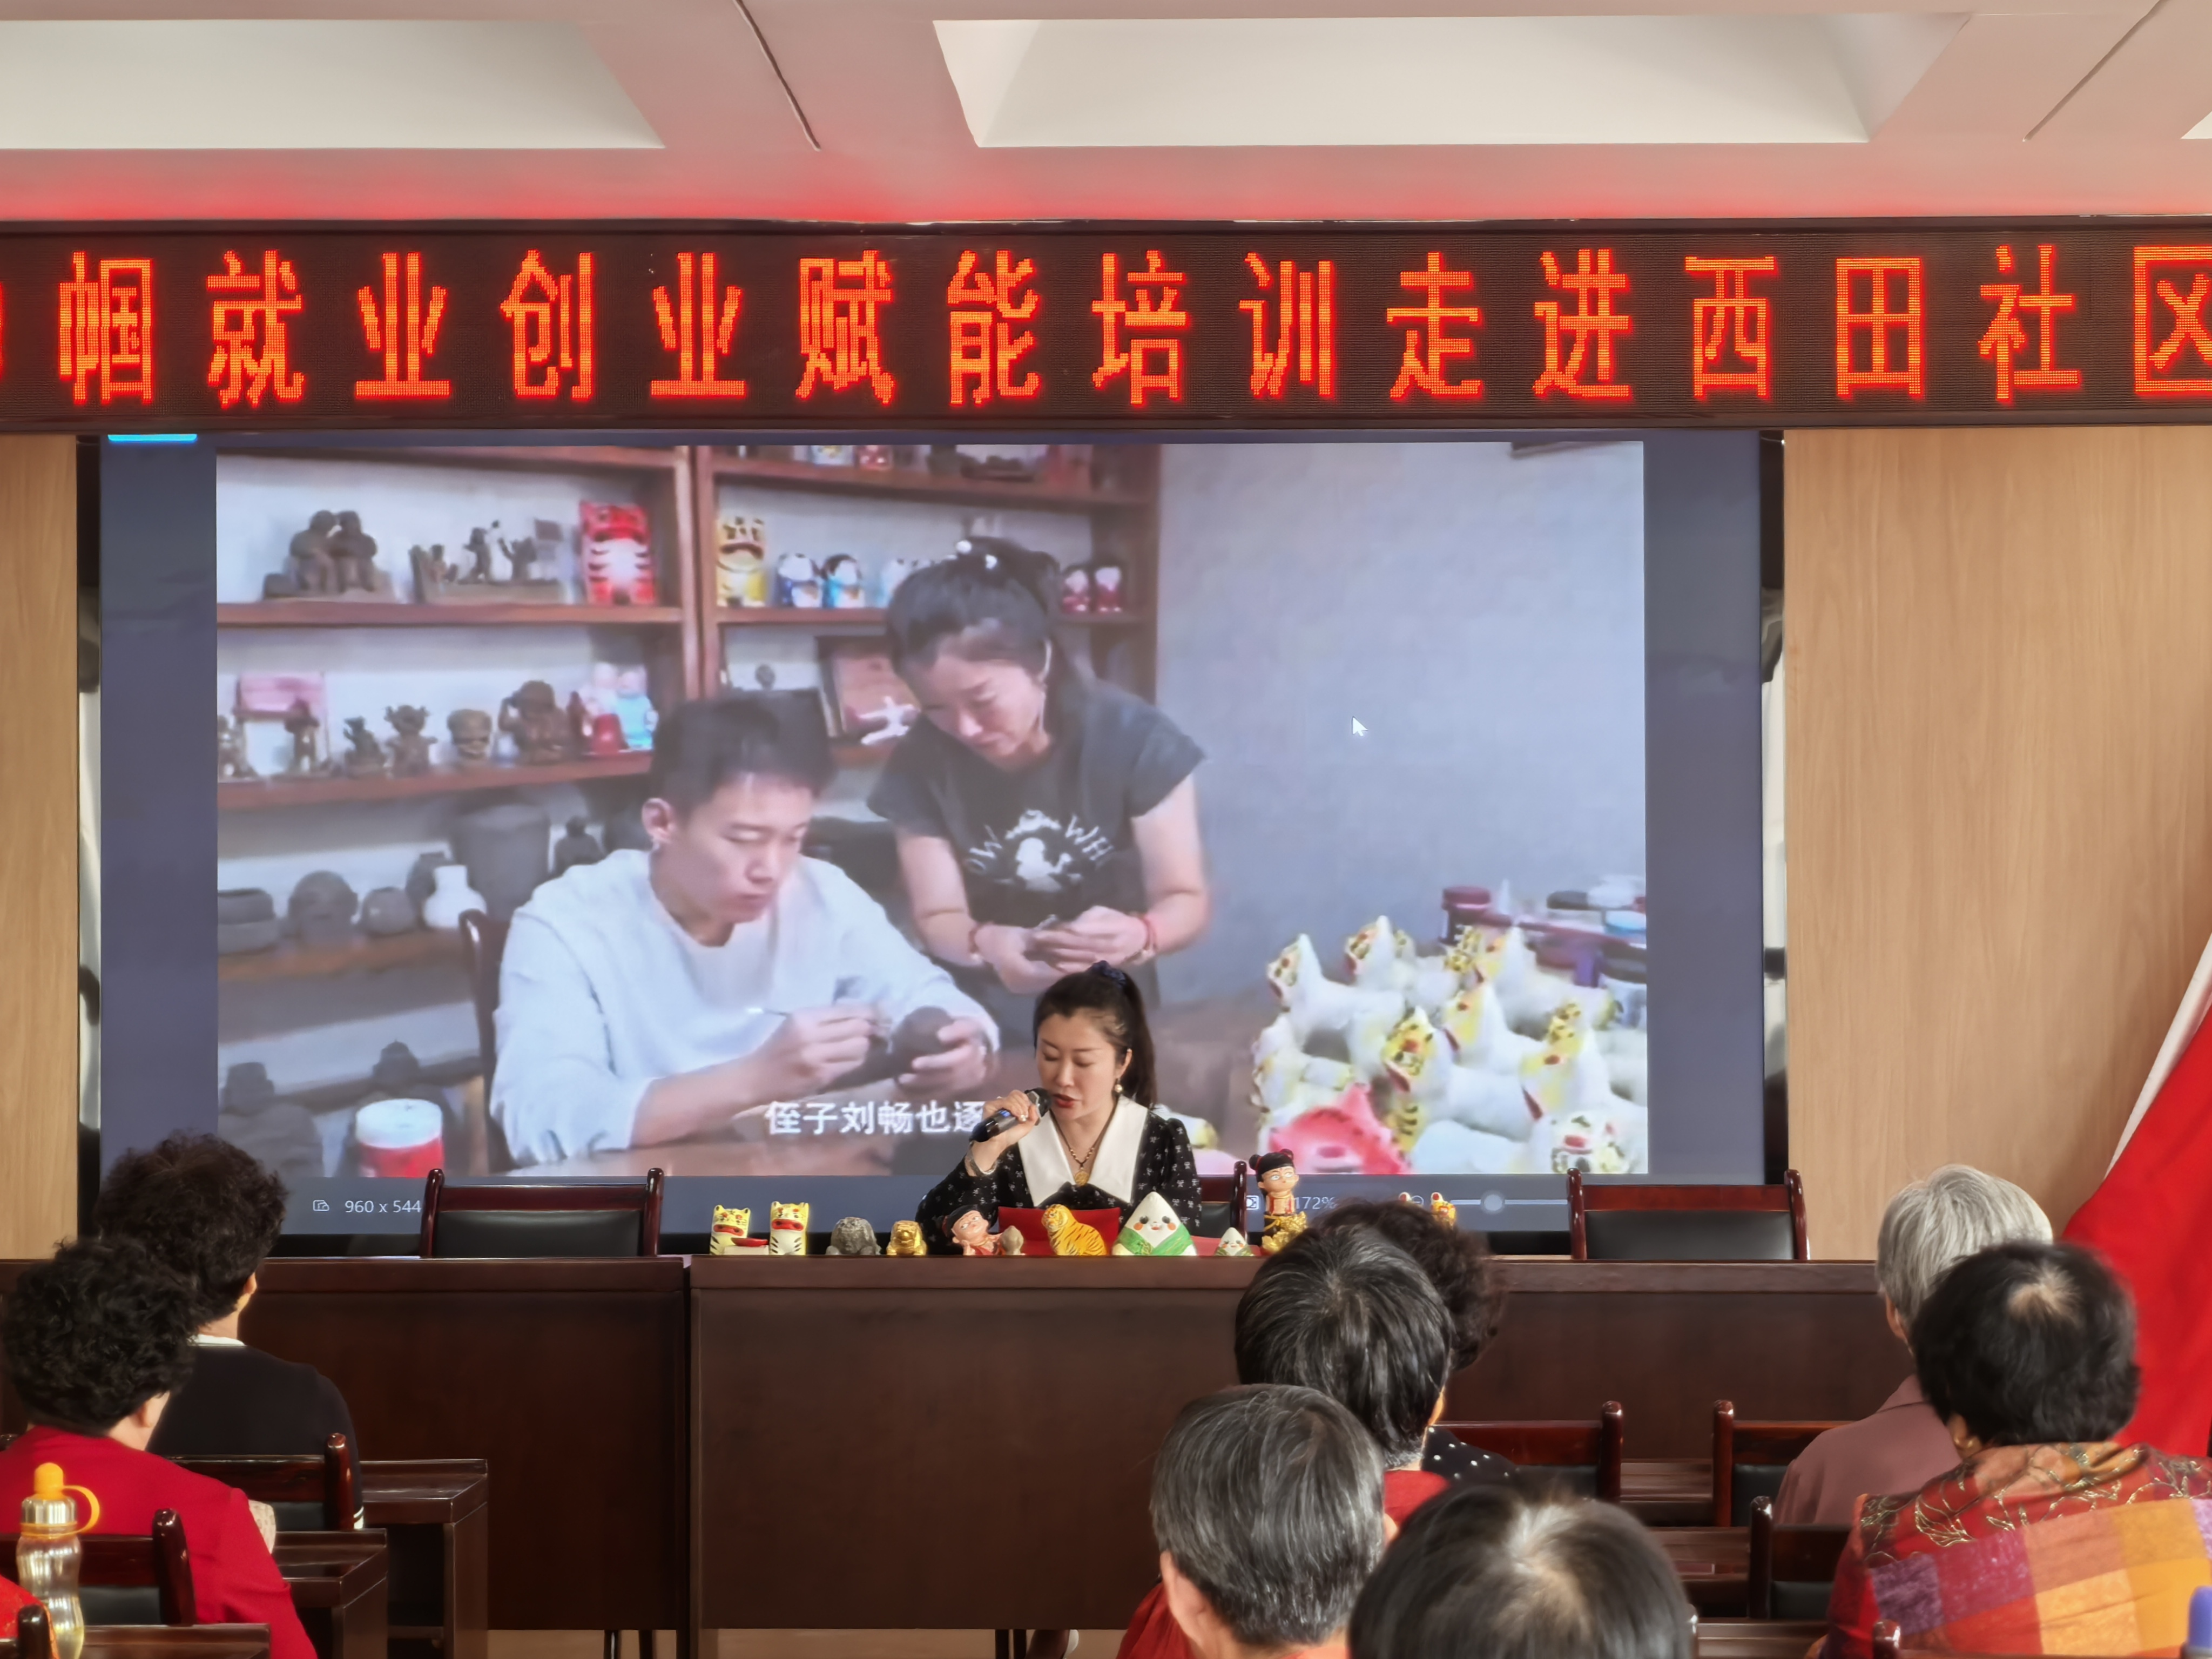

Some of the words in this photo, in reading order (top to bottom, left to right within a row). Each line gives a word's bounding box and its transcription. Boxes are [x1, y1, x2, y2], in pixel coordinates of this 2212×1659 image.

[0, 245, 2212, 408] 帼就业创业赋能培训走进西田社区
[345, 1200, 374, 1213] 960
[393, 1200, 421, 1213] 544
